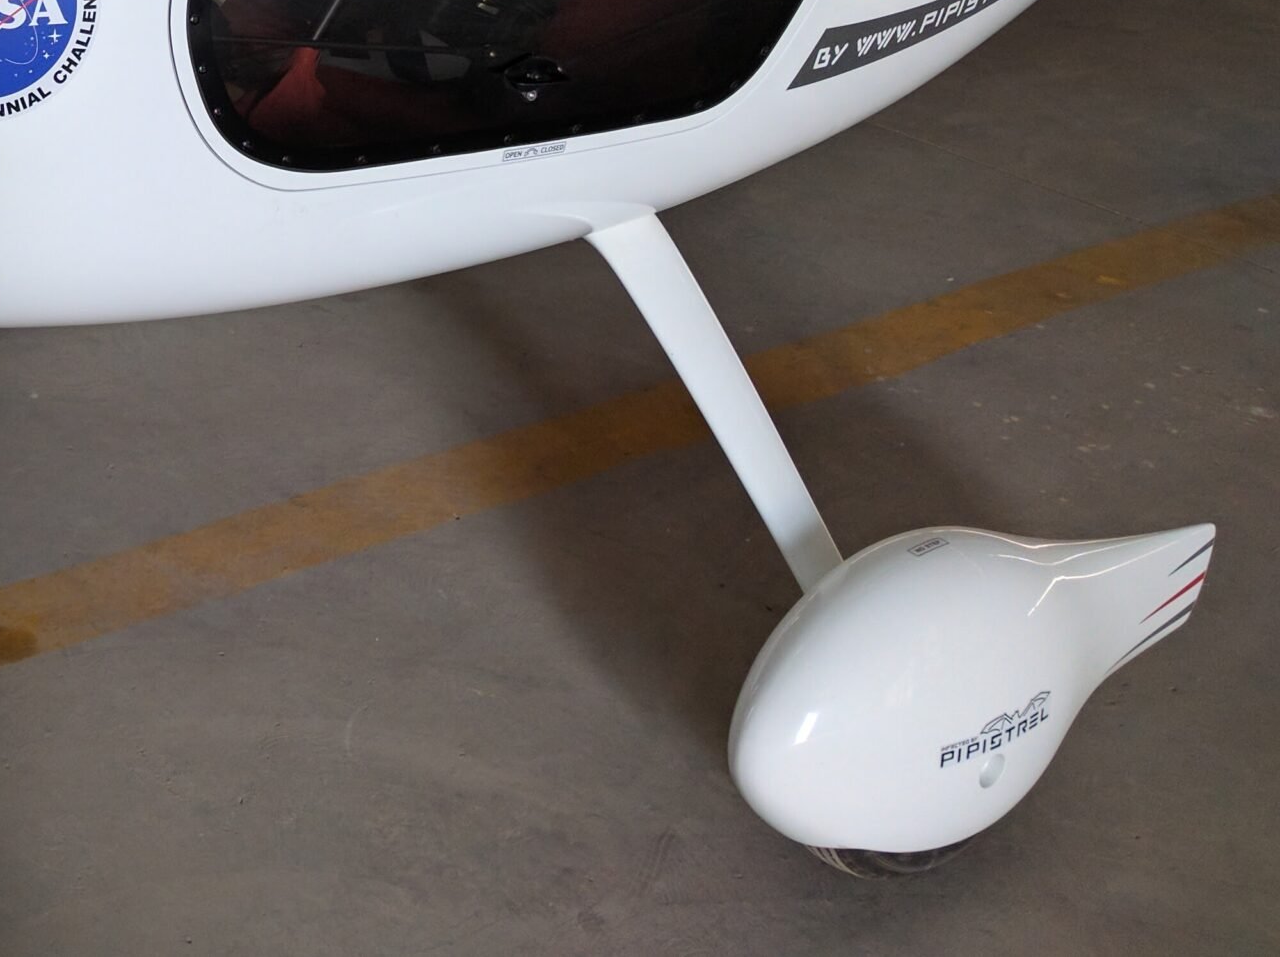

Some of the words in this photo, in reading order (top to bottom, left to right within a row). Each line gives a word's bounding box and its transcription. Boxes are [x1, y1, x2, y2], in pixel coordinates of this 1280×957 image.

[813, 43, 849, 70] BY
[505, 150, 522, 159] OPEN
[540, 144, 565, 154] CLOSED
[940, 708, 1049, 768] PIPISTREL
